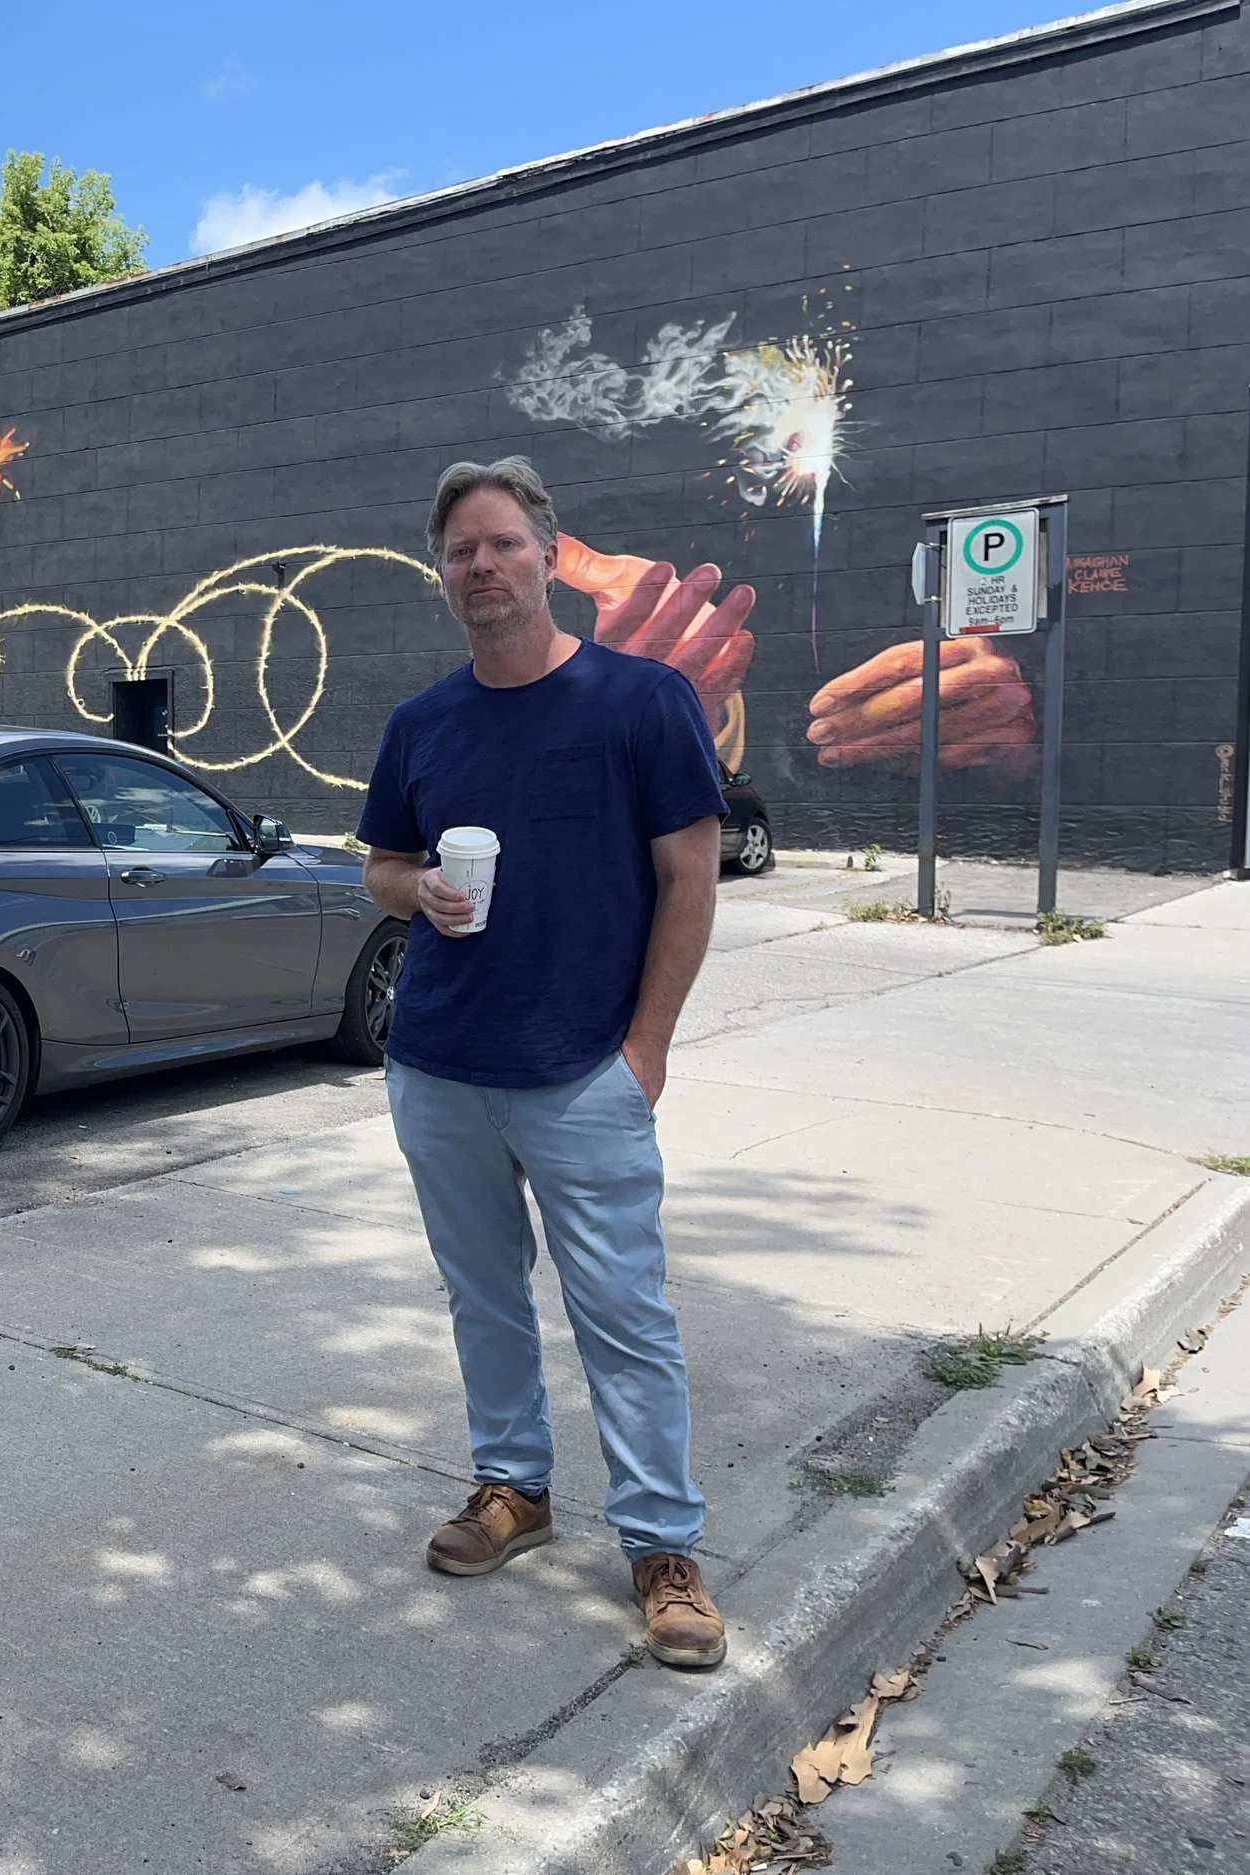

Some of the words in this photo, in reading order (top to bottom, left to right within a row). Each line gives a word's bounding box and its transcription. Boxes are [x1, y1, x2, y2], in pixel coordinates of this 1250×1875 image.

[984, 532, 1005, 562] P
[991, 575, 1005, 584] HR
[967, 586, 1006, 596] SUNDAY
[1011, 584, 1018, 593] &
[968, 594, 1017, 605] HOLIDAYS
[966, 603, 1019, 615] EXCEPTED
